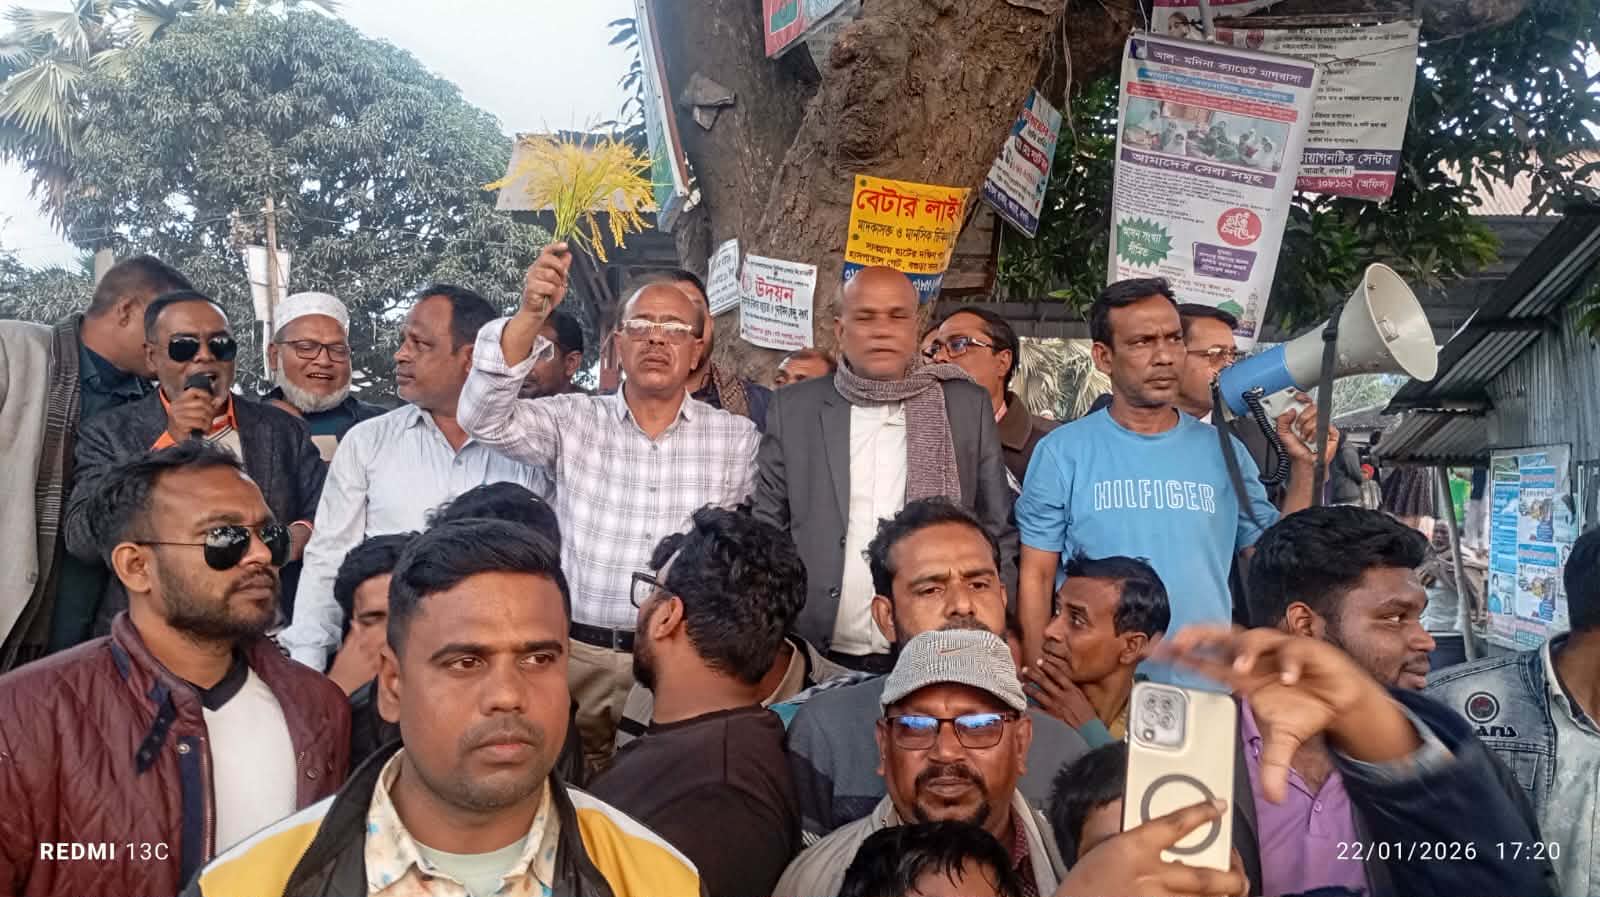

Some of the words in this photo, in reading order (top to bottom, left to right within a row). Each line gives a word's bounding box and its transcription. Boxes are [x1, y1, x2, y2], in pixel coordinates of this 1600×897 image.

[1183, 54, 1214, 69] মদিনা
[1218, 61, 1257, 77] ক্যাডেট
[1131, 151, 1191, 171] আমাদের
[1194, 164, 1226, 178] সেবা
[1231, 169, 1265, 186] সমূহ
[1358, 152, 1393, 166] সেন্টার
[857, 188, 918, 218] বেটার
[896, 228, 902, 238] ও
[905, 227, 932, 240] মানসিক
[755, 274, 796, 306] উদয়ন
[1094, 479, 1216, 515] HILFIGER
